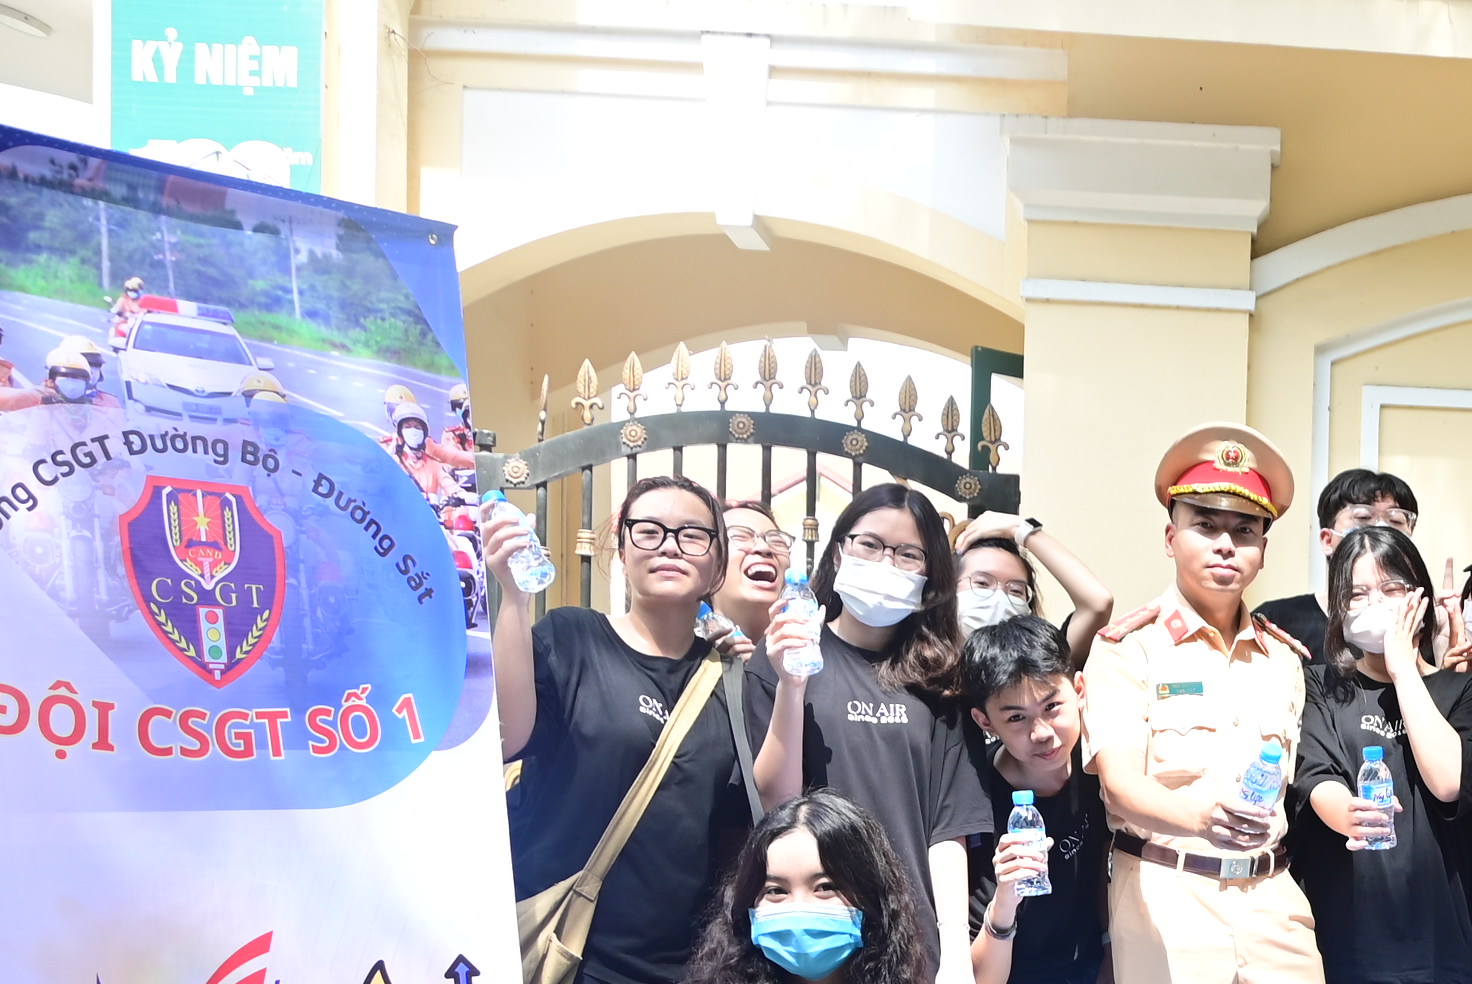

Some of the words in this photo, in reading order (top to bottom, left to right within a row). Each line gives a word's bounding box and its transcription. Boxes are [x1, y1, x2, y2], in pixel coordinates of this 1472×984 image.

[131, 27, 183, 83] KỶ
[194, 35, 298, 96] NIỆM
[32, 433, 113, 487] CSGT
[122, 427, 229, 466] Đường
[240, 439, 280, 474] Bộ
[311, 472, 396, 558] Đường
[396, 553, 436, 606] Sắt
[188, 547, 223, 560] CAND
[0, 679, 117, 760] ĐỘI
[137, 705, 291, 760] CSGT
[307, 684, 382, 757] SỐ
[392, 692, 425, 745] 1
[847, 700, 875, 716] ON
[877, 702, 906, 717] AIR
[1360, 714, 1386, 728] ON
